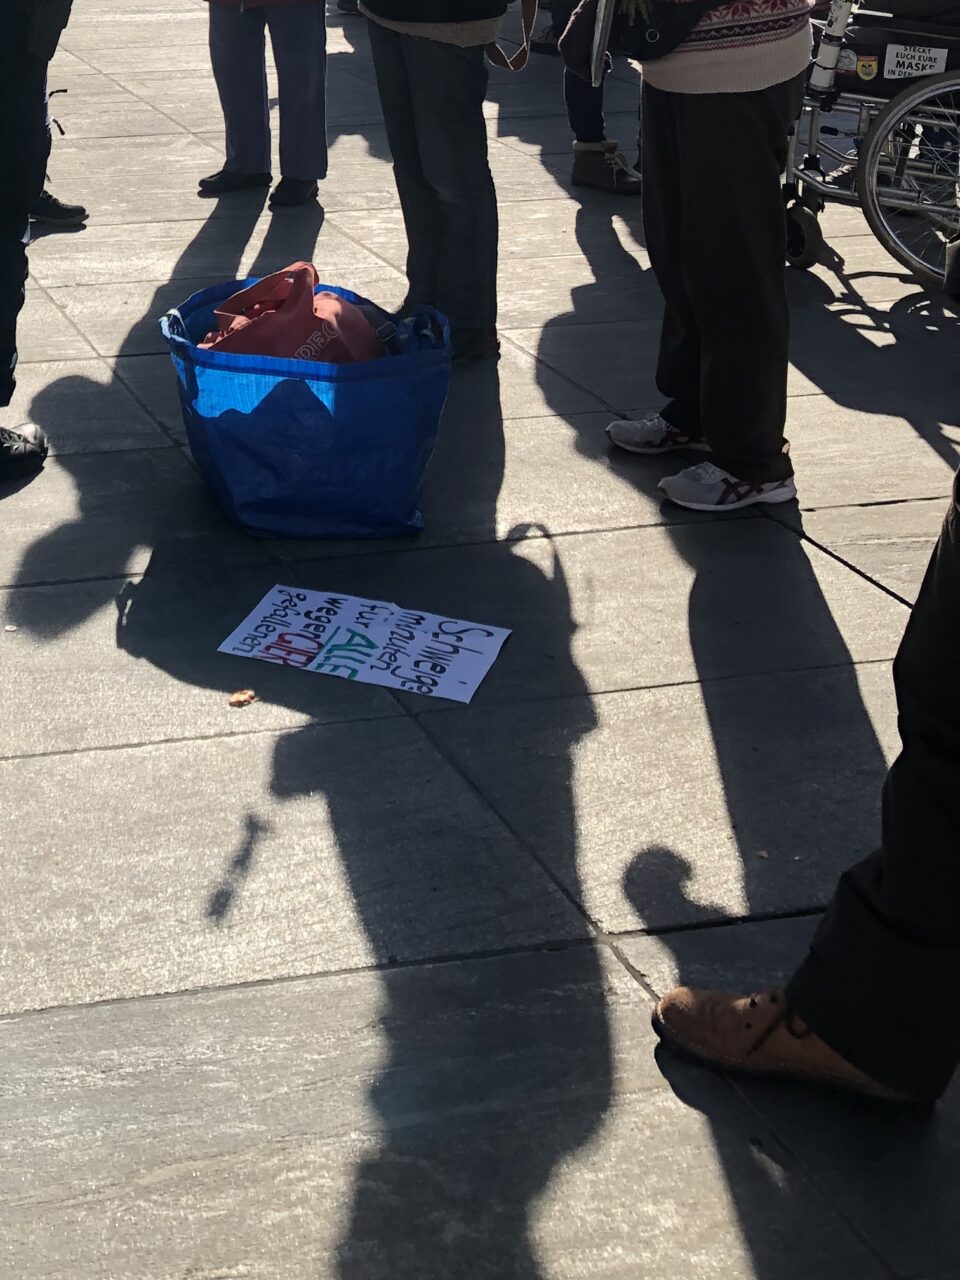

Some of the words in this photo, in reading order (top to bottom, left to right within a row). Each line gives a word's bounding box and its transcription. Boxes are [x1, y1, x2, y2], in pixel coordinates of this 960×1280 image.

[895, 51, 916, 61] EUCH
[917, 54, 938, 64] EURE
[903, 45, 932, 55] STECKT
[299, 597, 349, 644] wegen
[354, 603, 396, 629] für
[252, 632, 325, 669] GIER
[315, 627, 380, 681] ALLE
[369, 611, 428, 671] minuten
